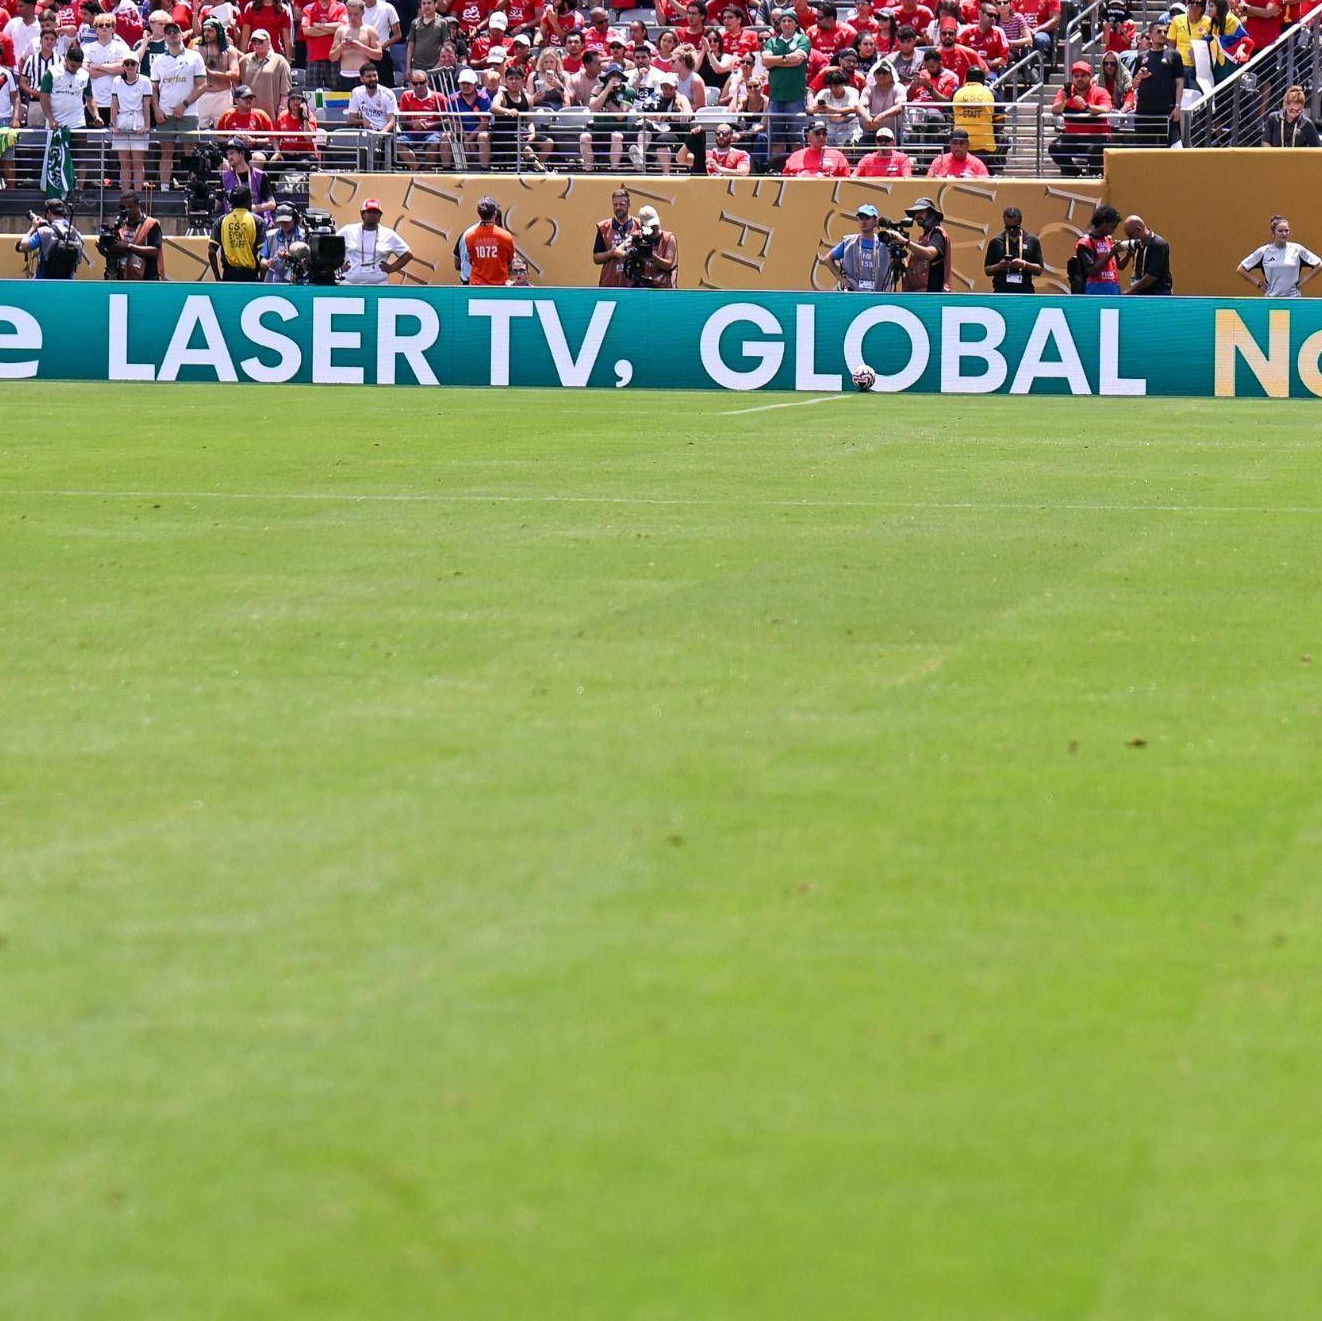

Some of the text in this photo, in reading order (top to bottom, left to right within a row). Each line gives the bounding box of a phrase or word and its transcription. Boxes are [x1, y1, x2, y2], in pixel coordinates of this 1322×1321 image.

[475, 245, 499, 258] 1072
[107, 293, 442, 387] LASER
[467, 299, 634, 389] TV,
[699, 302, 1147, 396] GLOBAL
